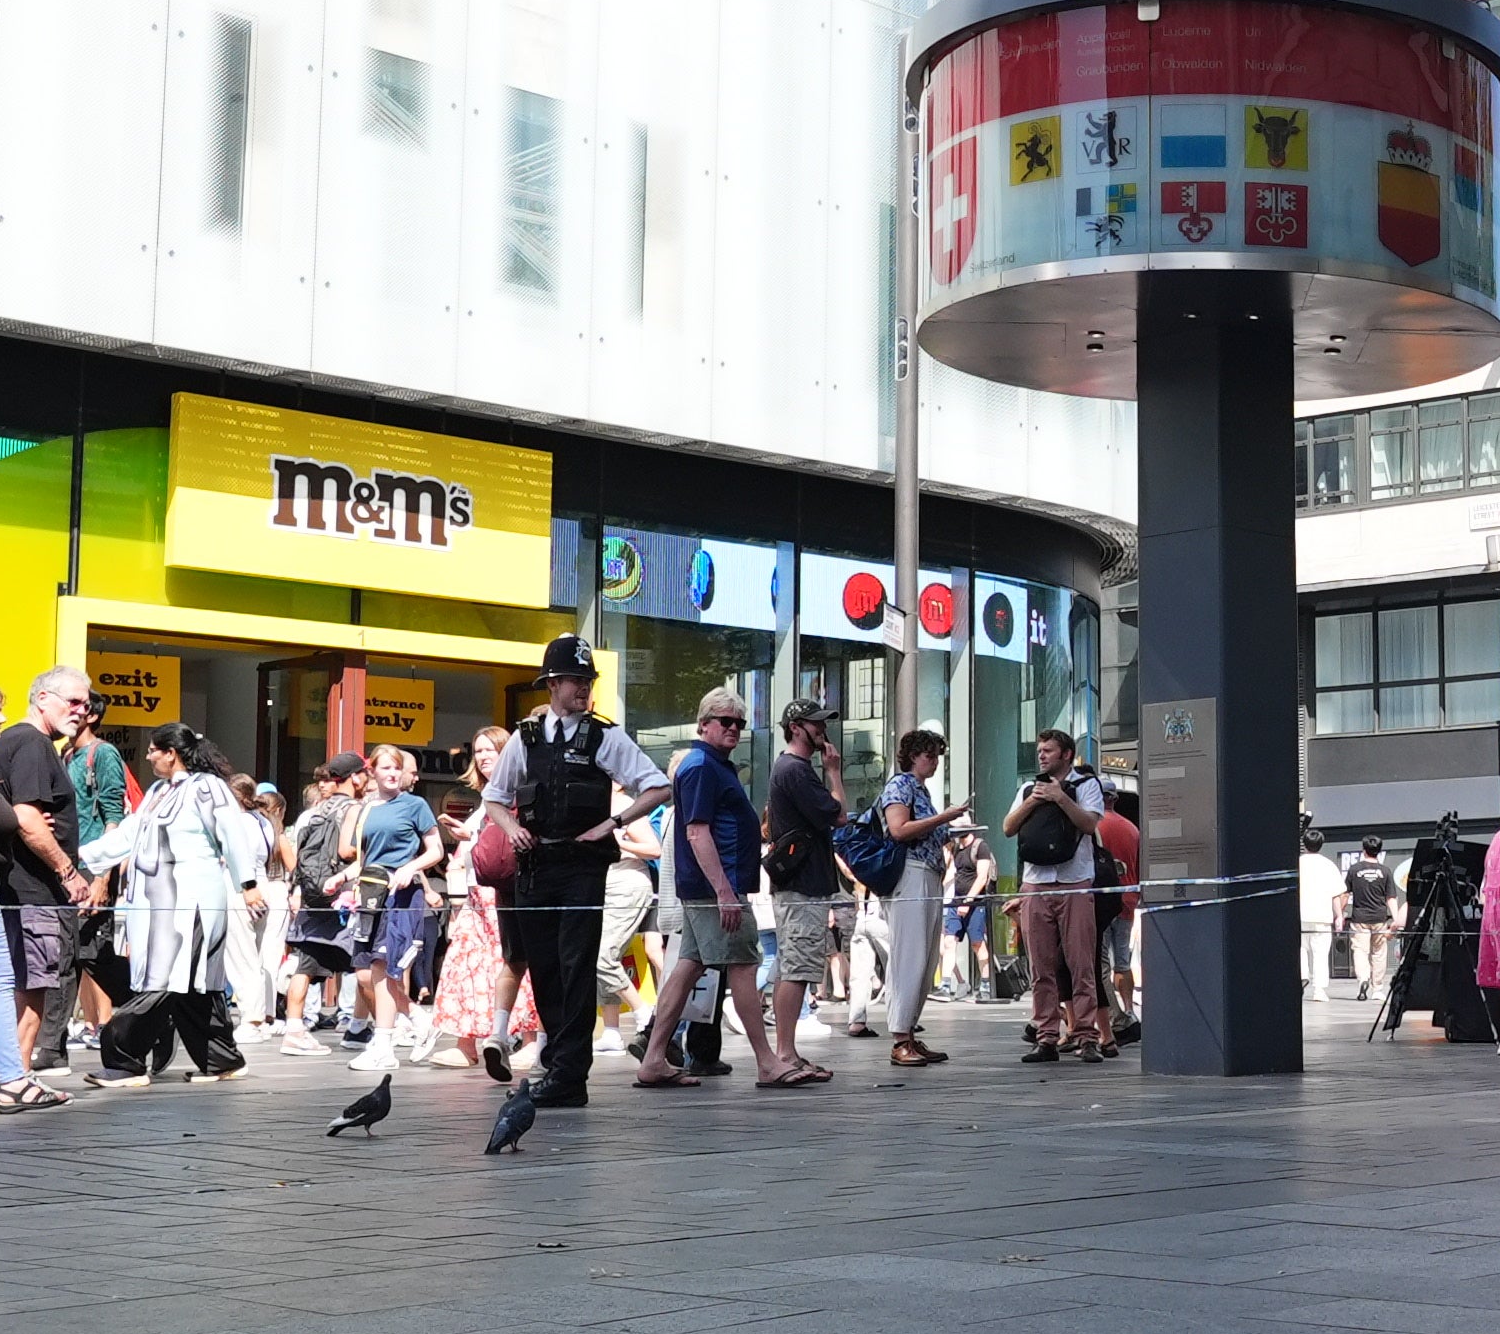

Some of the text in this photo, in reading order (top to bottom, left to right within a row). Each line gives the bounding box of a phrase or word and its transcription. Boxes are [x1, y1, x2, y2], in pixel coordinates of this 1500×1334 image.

[1161, 58, 1223, 71] Obwalden
[1245, 58, 1307, 74] Nidwalden
[1029, 608, 1048, 647] it
[98, 669, 159, 689] exit
[364, 697, 426, 711] ntrance
[364, 713, 416, 732] only
